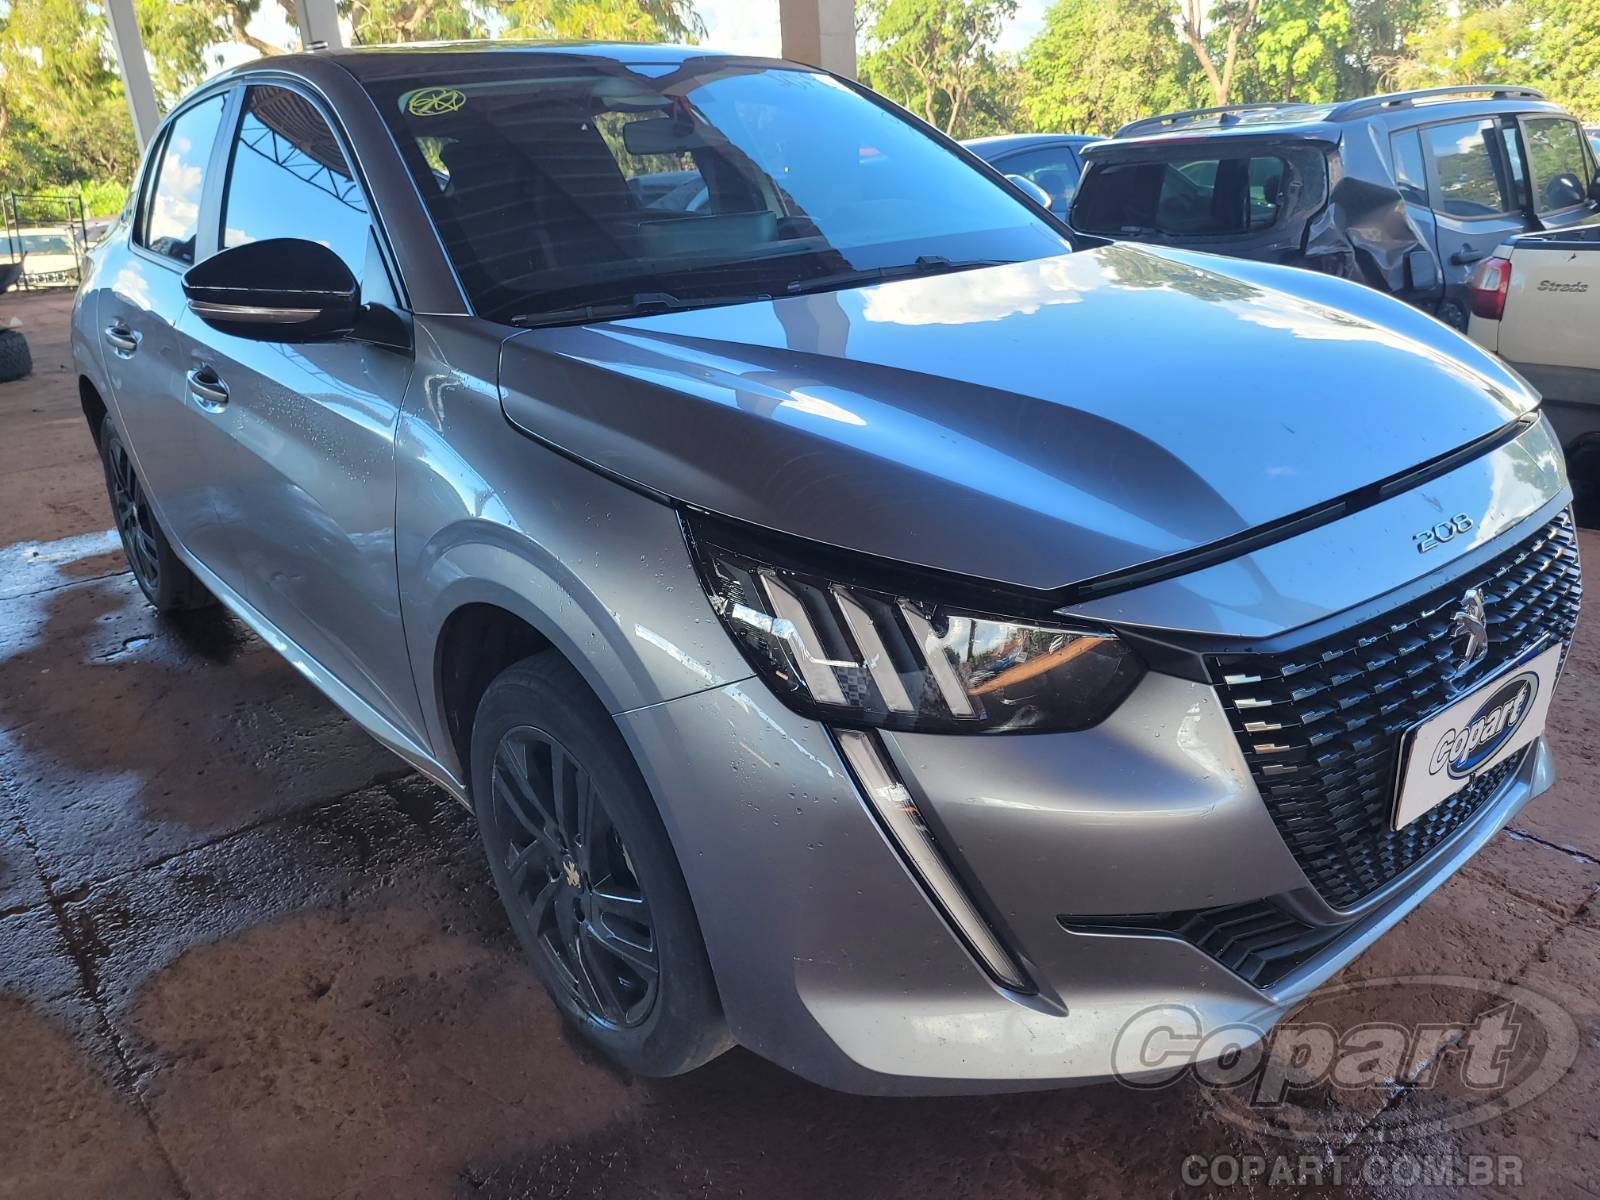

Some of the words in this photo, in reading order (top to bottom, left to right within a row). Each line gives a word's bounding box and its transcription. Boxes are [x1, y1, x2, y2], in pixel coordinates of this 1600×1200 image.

[1537, 280, 1589, 292] Strada
[1412, 513, 1473, 553] 208
[1429, 680, 1529, 775] Copart
